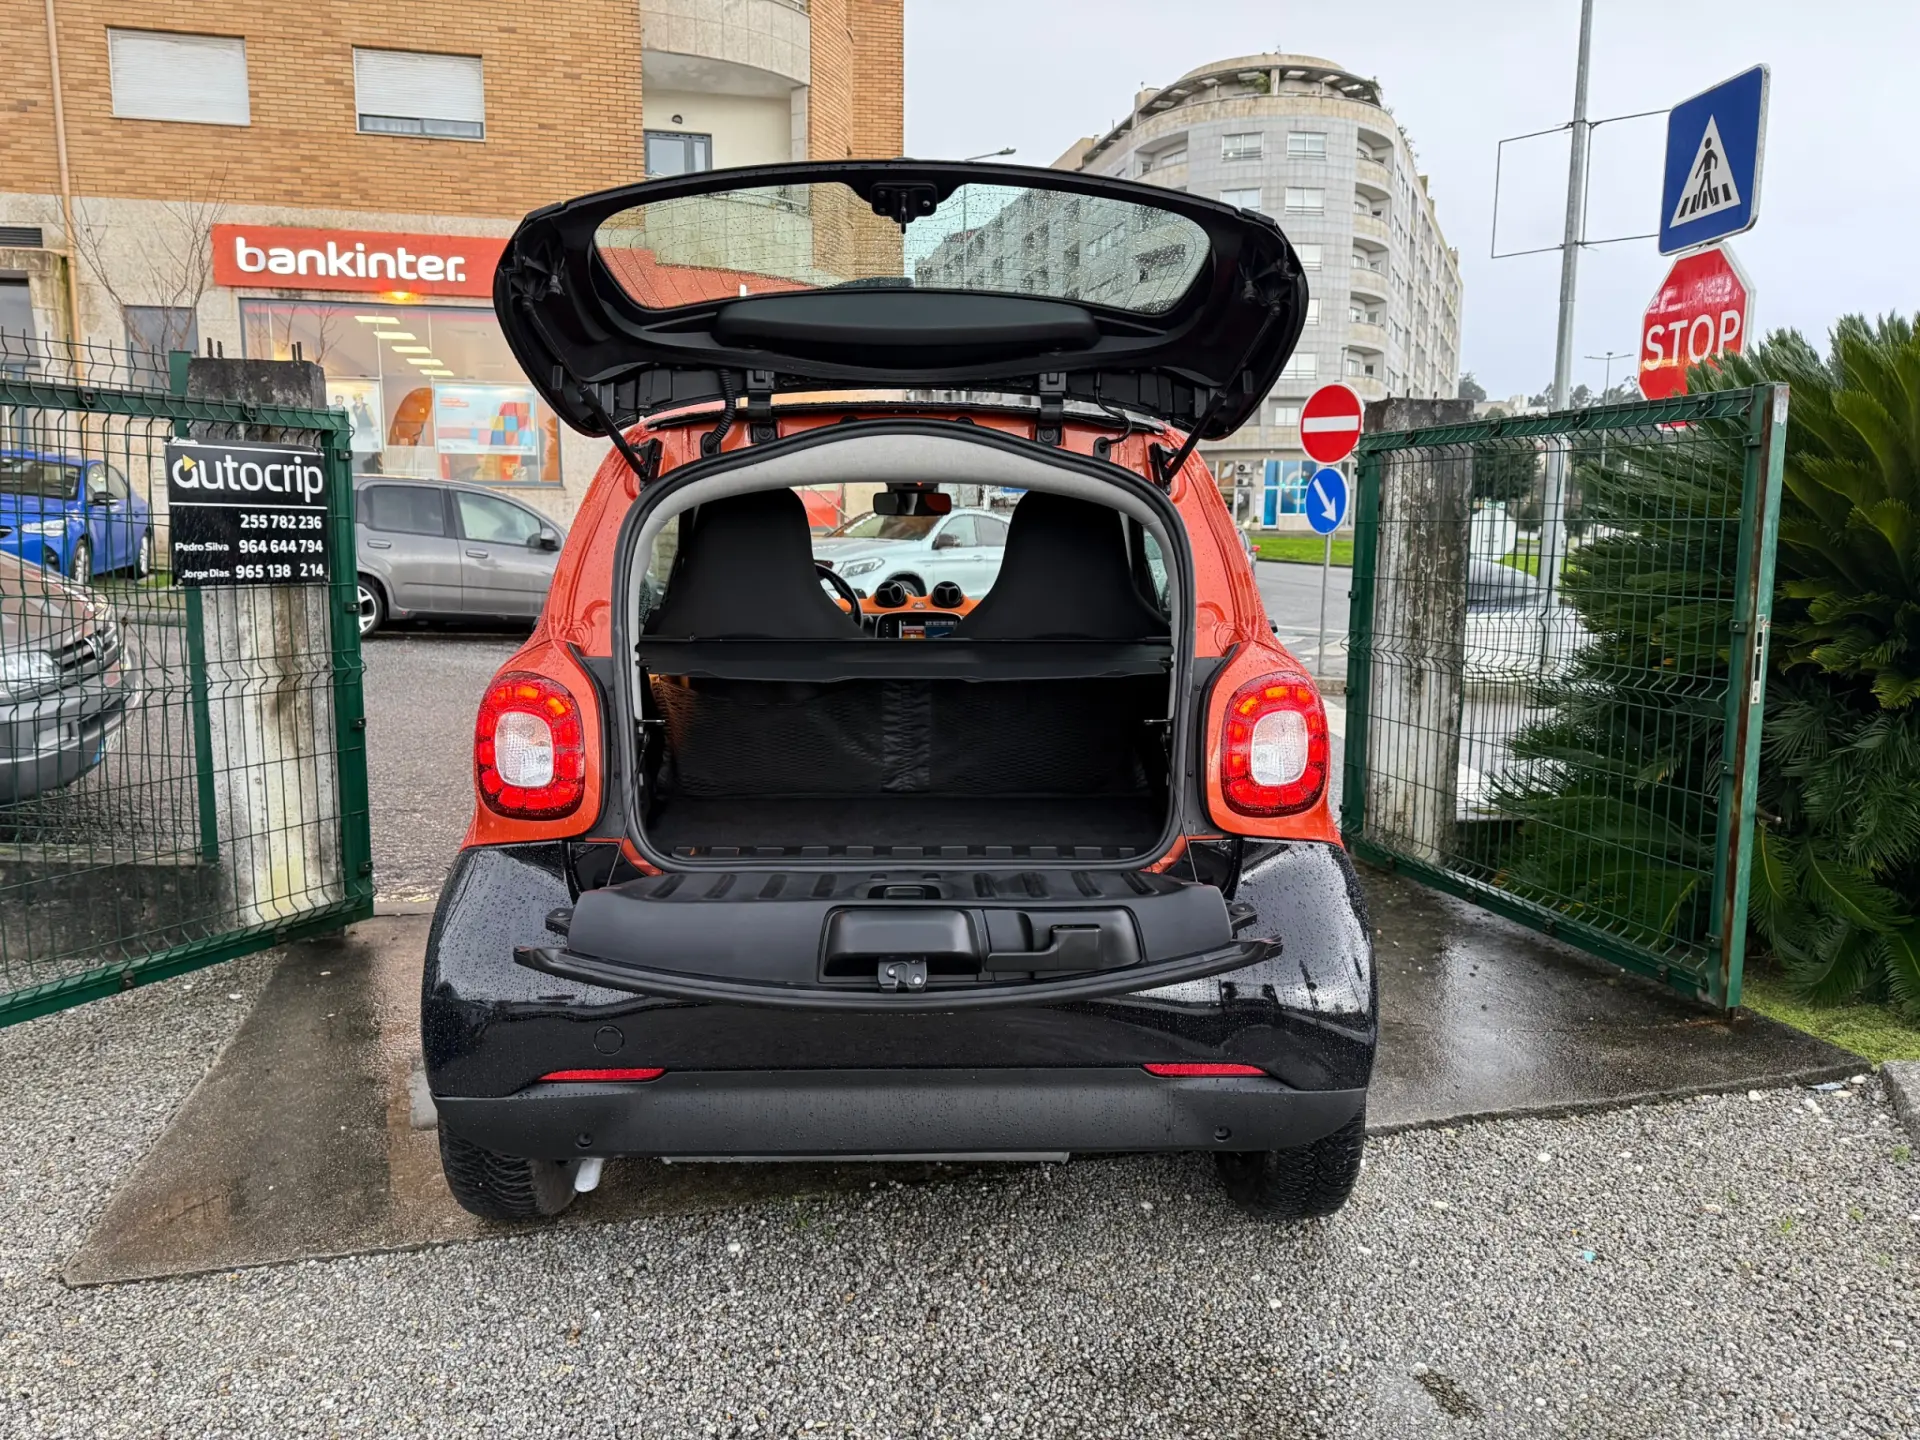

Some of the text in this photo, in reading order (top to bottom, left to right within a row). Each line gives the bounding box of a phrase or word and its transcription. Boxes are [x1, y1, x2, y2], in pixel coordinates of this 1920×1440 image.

[235, 236, 466, 281] bankinter.
[1644, 309, 1741, 371] STOP
[172, 454, 324, 503] autocrip
[240, 514, 322, 529] 255 782 236
[175, 540, 323, 553] Pedro Silva 964 644 794
[182, 563, 324, 580] Jorge Dias 965 138 214
